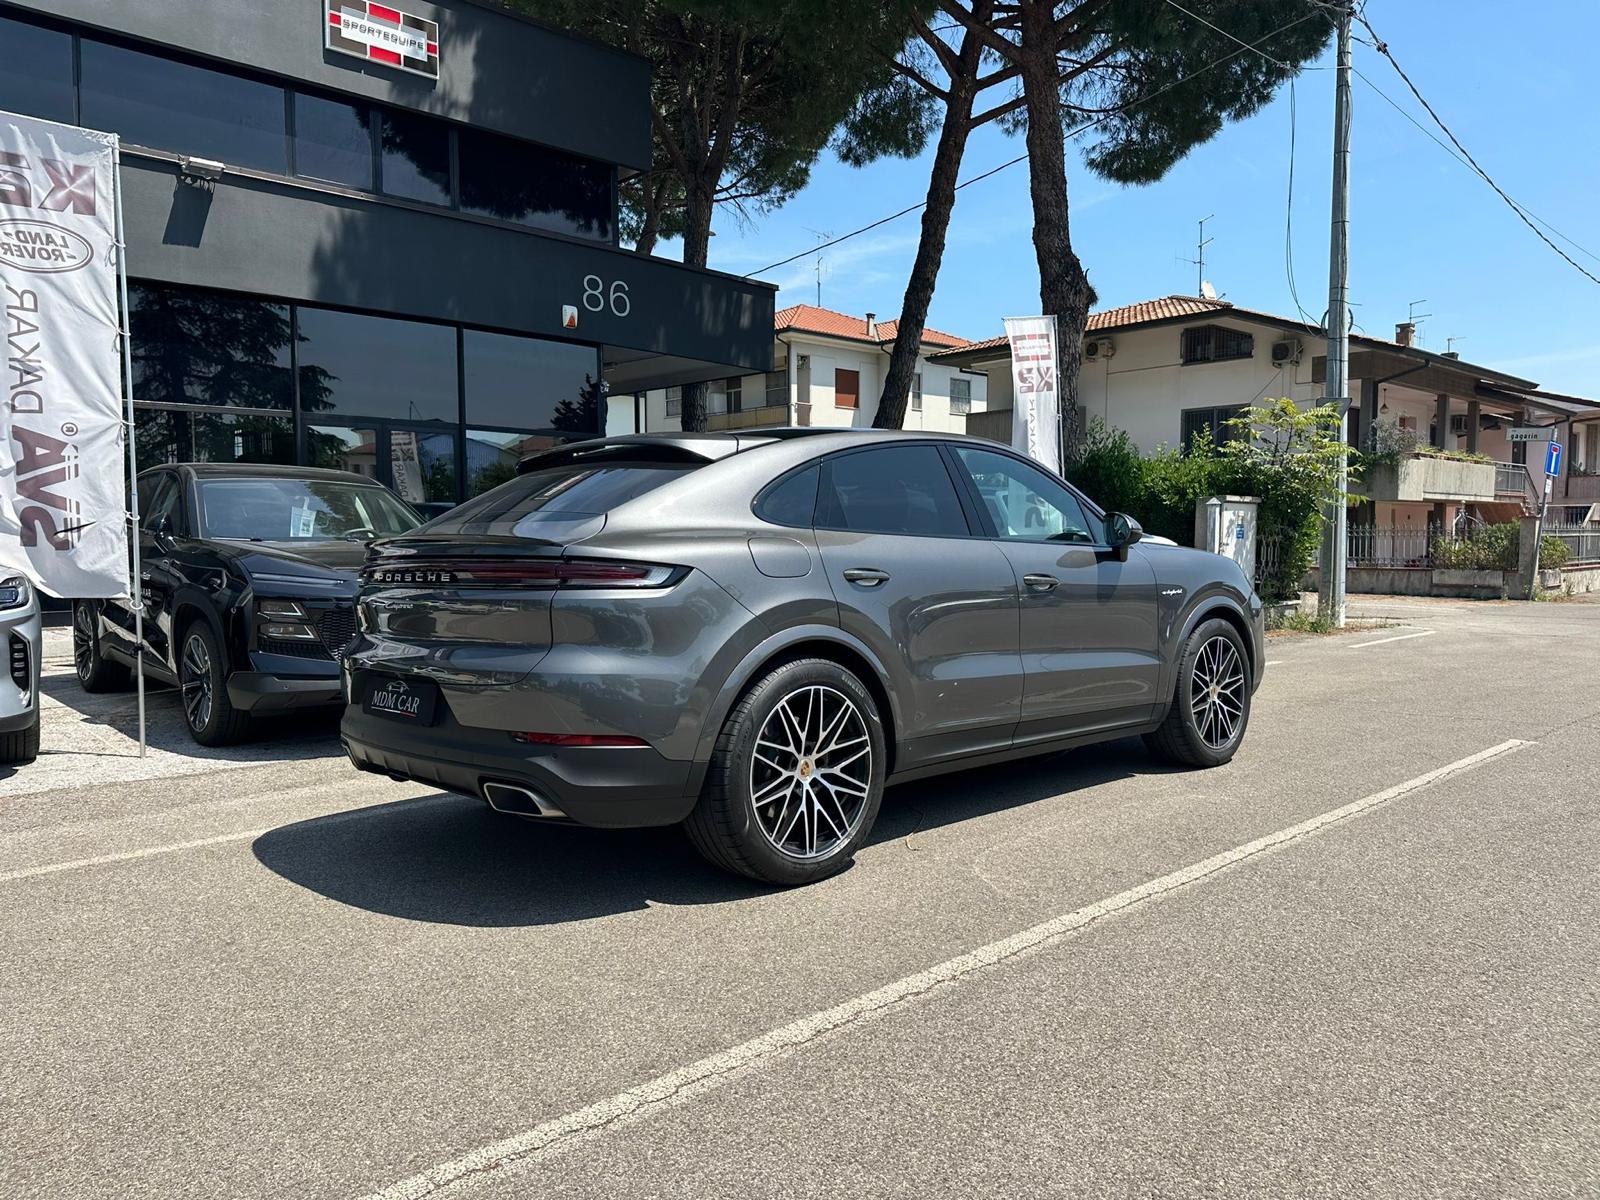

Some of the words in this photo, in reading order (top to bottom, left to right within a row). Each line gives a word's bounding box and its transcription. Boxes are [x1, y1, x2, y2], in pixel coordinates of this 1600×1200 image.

[342, 18, 424, 50] SPORTEQUIPE
[583, 274, 630, 317] 86
[377, 572, 451, 582] PORSCHE
[371, 690, 397, 709] MDM
[397, 695, 420, 713] CAR
